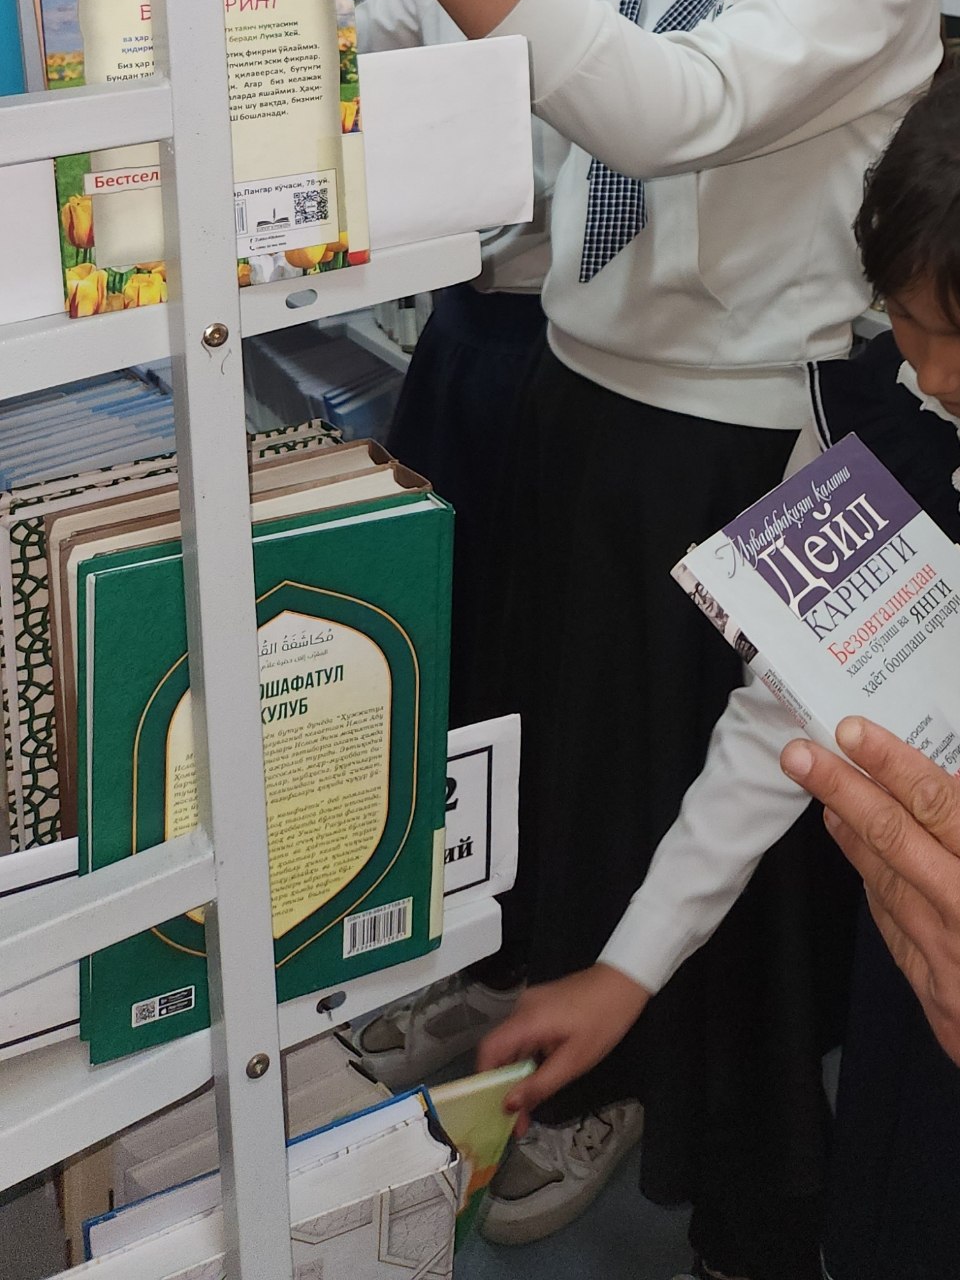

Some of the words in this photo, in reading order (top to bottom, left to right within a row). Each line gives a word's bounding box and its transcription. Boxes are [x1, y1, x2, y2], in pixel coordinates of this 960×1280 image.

[94, 171, 159, 189] Бестсел
[811, 465, 851, 503] калити
[757, 493, 889, 617] Дейл
[802, 532, 918, 643] КАРНЕГИ
[827, 563, 937, 666] Безовталикдан
[846, 650, 873, 678] халос
[869, 623, 900, 653] бўлиш
[897, 615, 909, 628] ва
[909, 578, 953, 625] ЯНГИ
[884, 630, 927, 674] бошлаш
